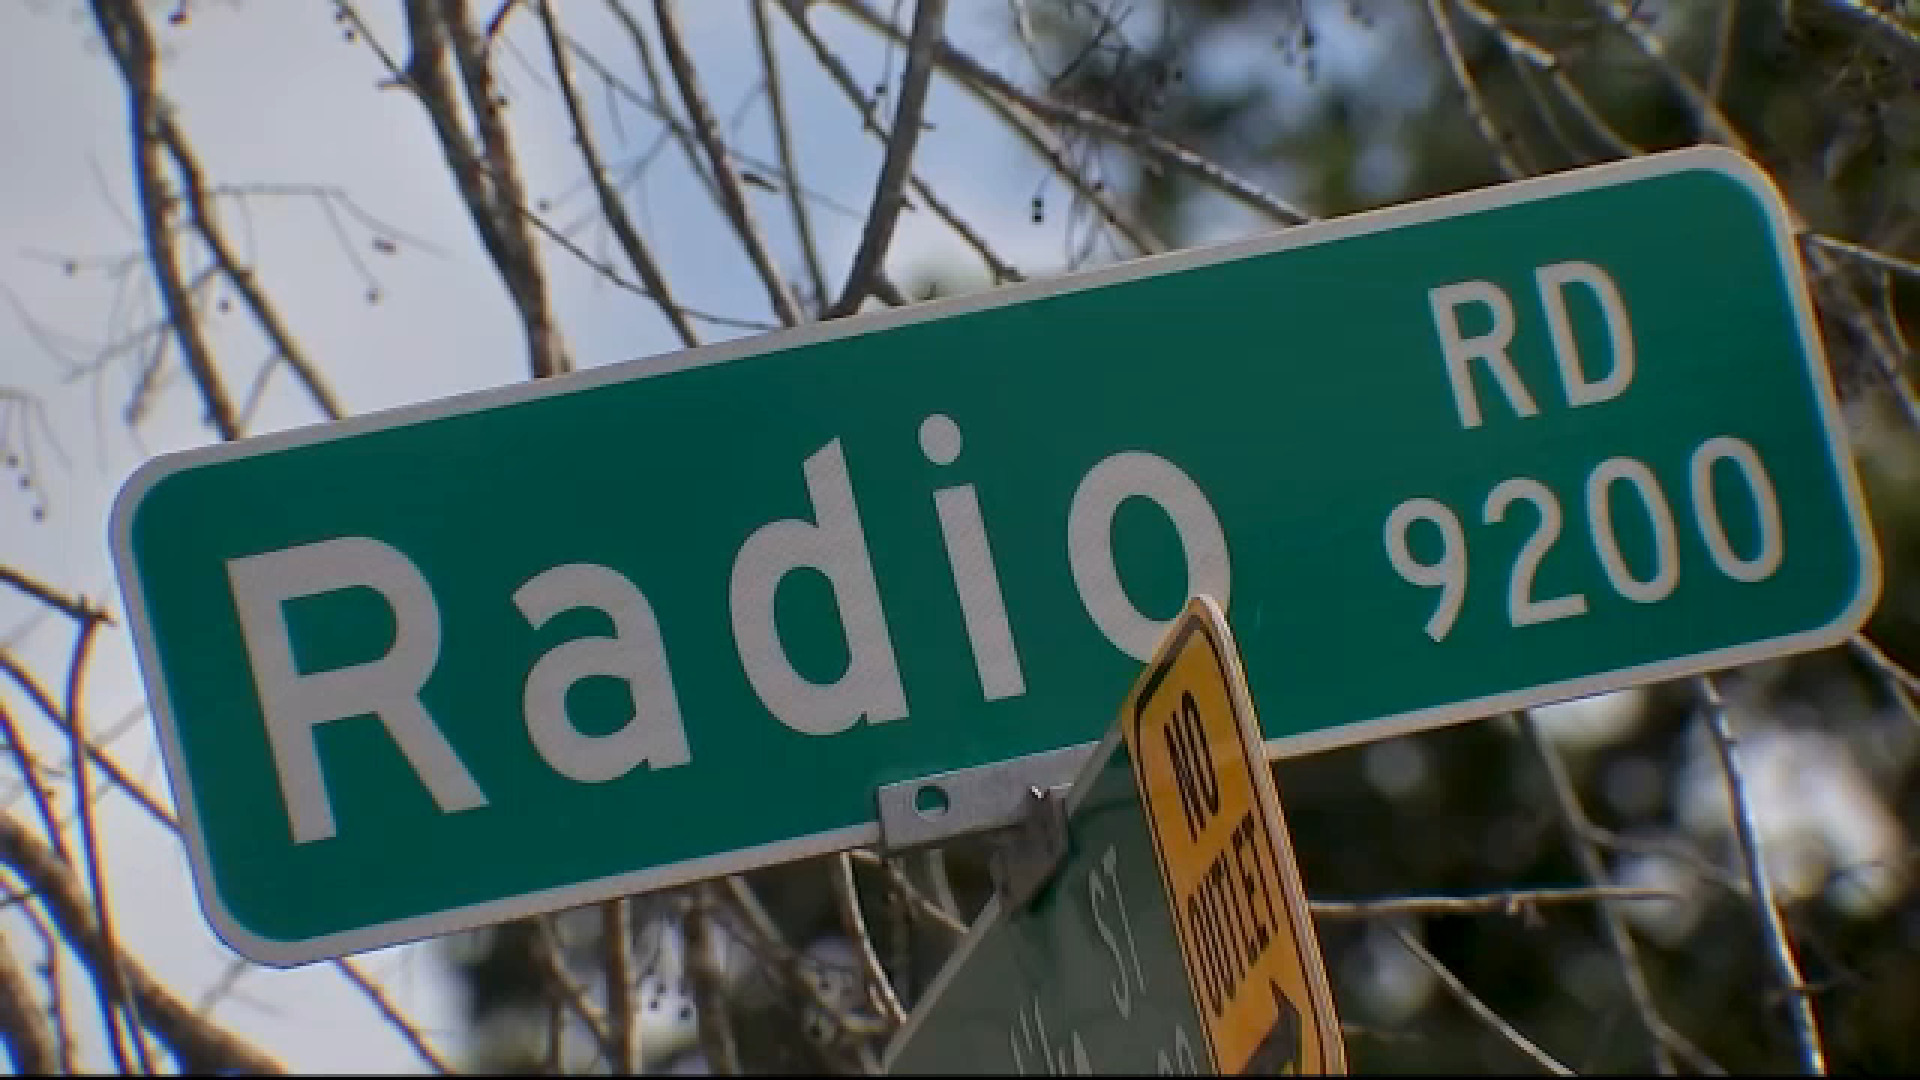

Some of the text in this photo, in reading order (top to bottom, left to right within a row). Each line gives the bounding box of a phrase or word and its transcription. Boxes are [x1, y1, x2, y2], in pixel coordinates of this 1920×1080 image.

[1428, 261, 1636, 429] RD
[226, 413, 1230, 845] Radio
[1383, 435, 1785, 642] 9200
[1164, 690, 1219, 843] NO
[1090, 844, 1147, 1019] ST
[1188, 812, 1278, 1017] OUTLET
